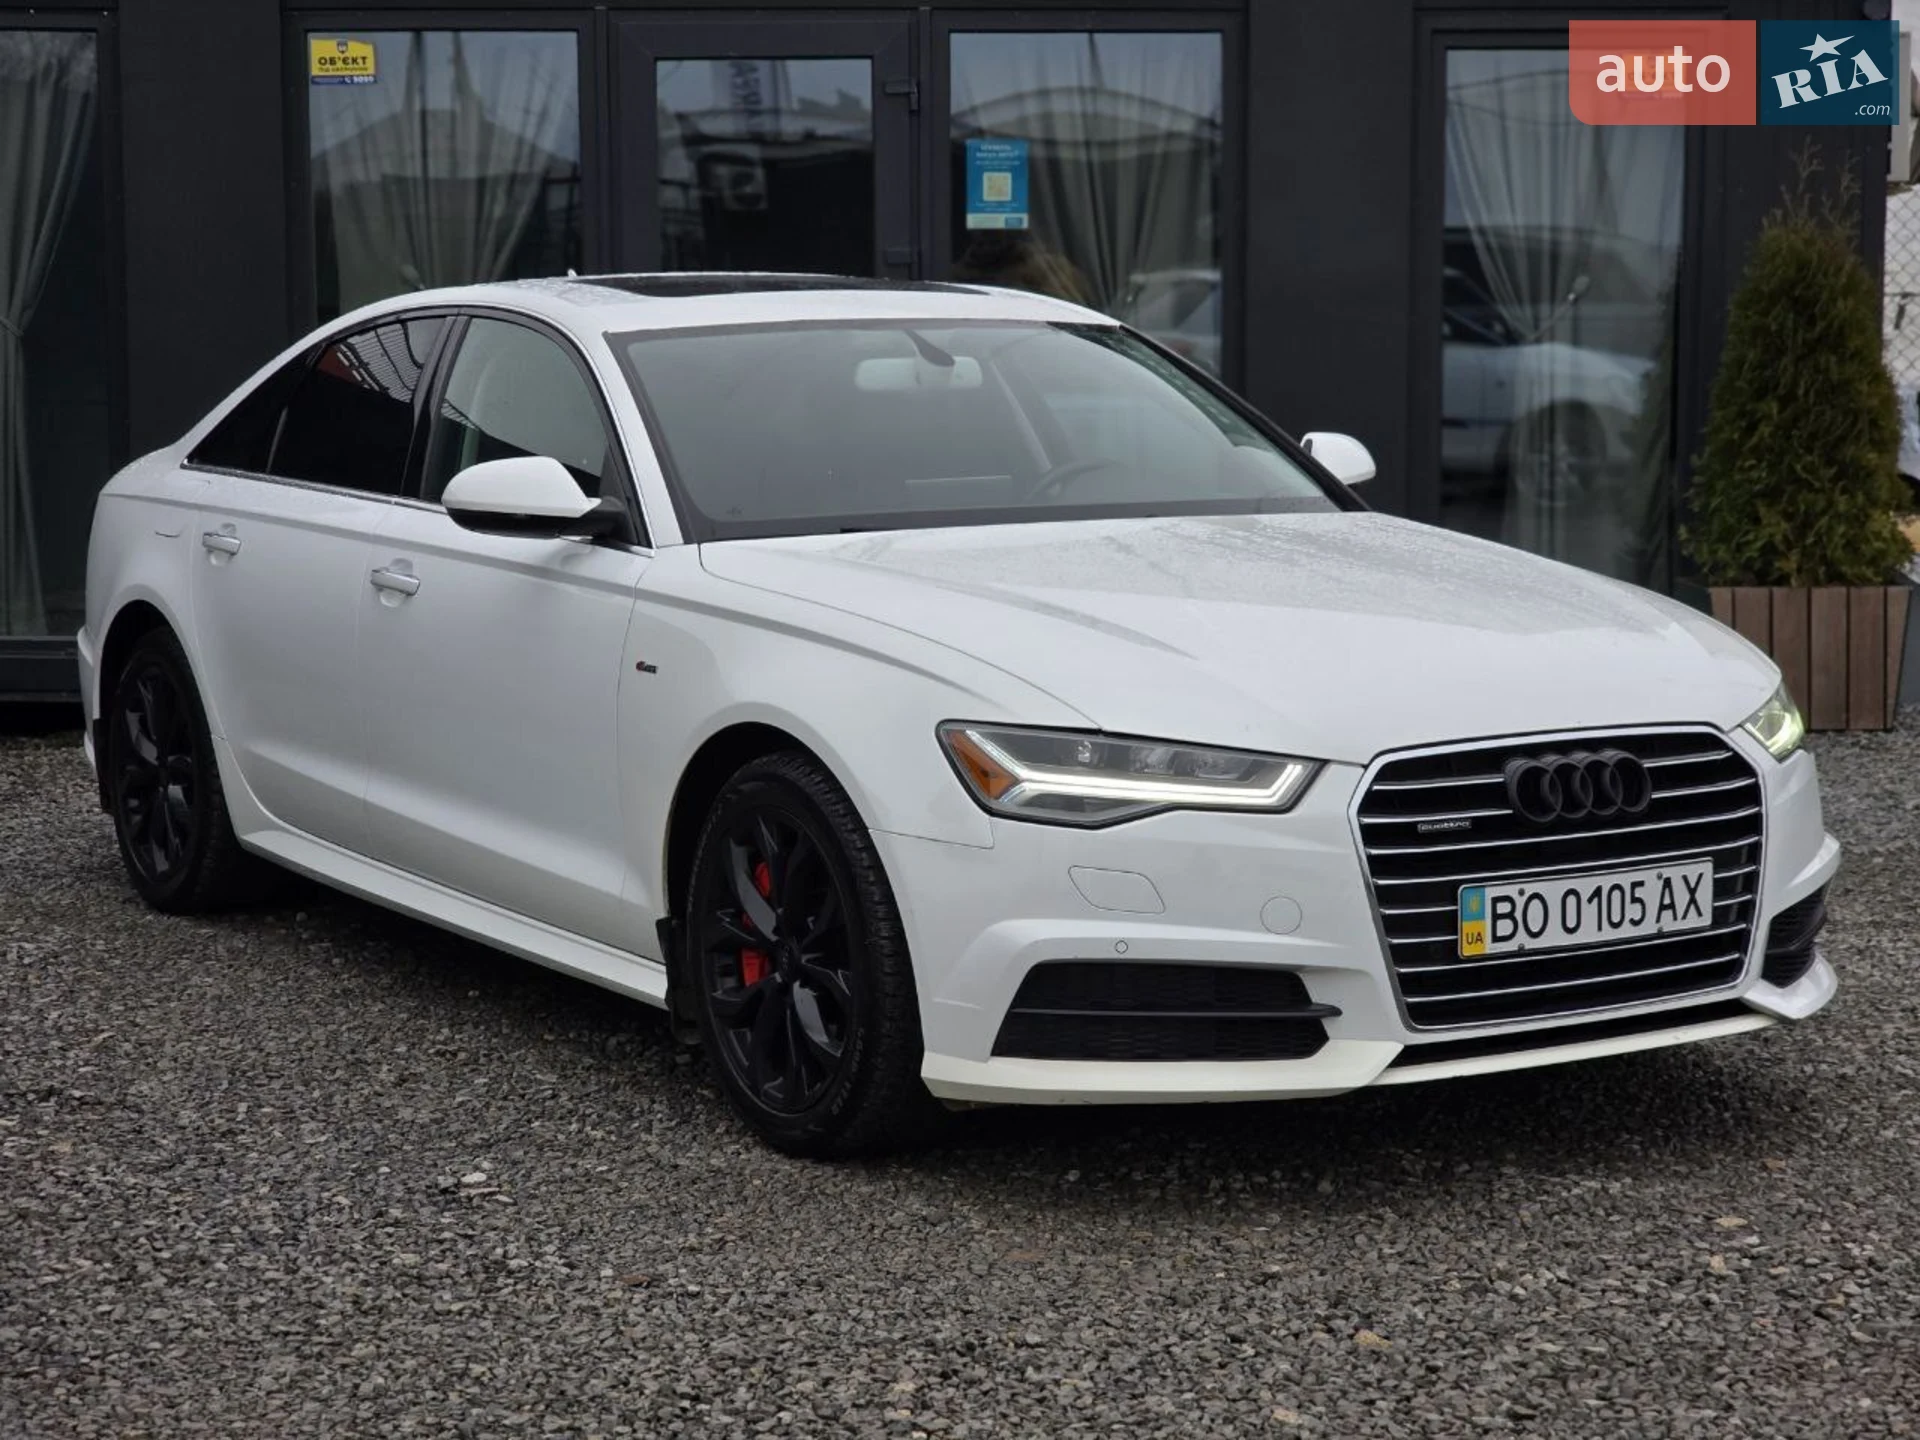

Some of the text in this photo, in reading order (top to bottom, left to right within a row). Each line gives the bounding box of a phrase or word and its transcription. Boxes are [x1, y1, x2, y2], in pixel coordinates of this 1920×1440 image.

[1490, 872, 1705, 944] BO 0105 AX
[1465, 931, 1484, 946] UA
